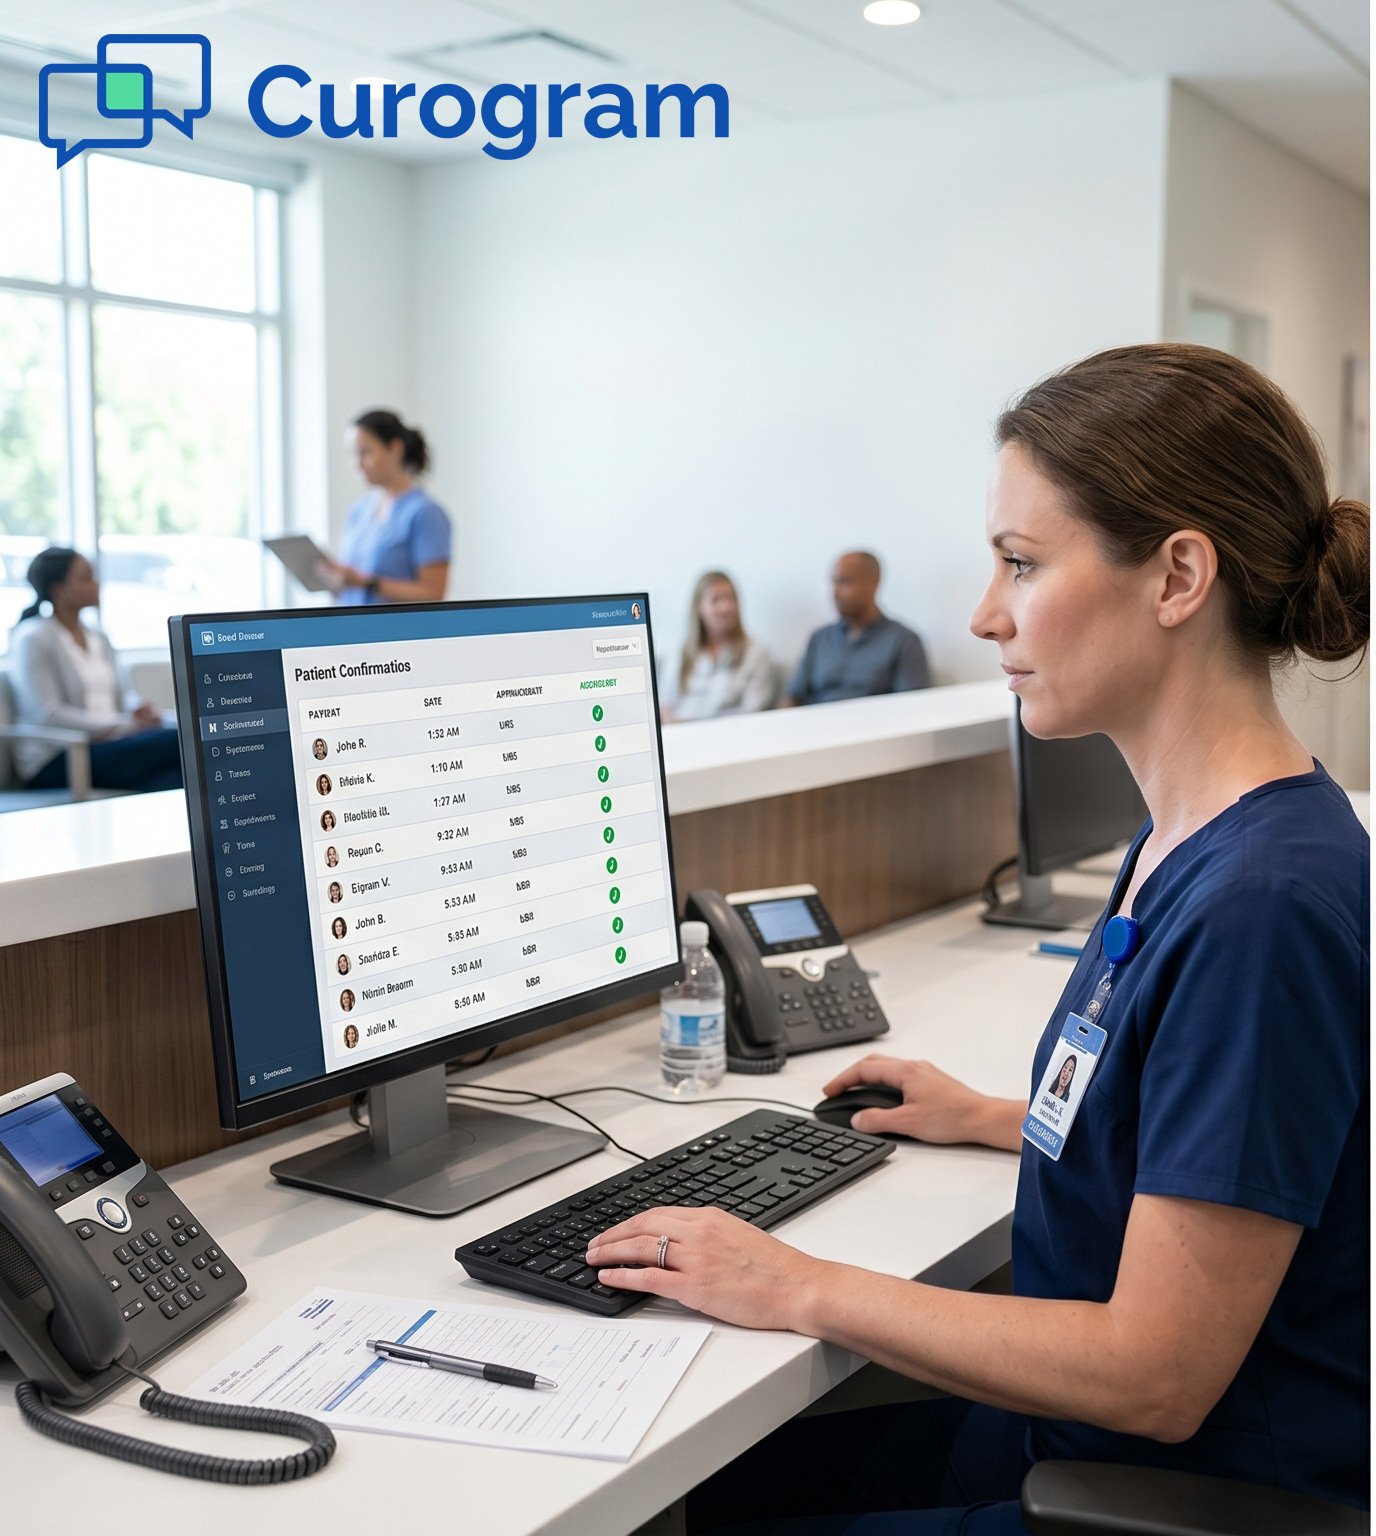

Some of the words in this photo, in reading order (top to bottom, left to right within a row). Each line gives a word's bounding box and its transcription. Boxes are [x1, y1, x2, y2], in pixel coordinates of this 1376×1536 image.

[295, 666, 337, 682] Patient
[339, 659, 411, 678] Confirmatios
[427, 728, 445, 740] 1:52
[446, 727, 460, 737] AM
[336, 740, 357, 754] Johe
[358, 738, 367, 749] R.
[430, 762, 448, 773] 1:10
[450, 760, 463, 771] AM
[366, 773, 375, 783] K.
[433, 796, 450, 807] 1:27
[452, 793, 466, 804] AM
[437, 829, 454, 841] 9:32
[456, 827, 469, 838] AM
[375, 842, 384, 853] C.
[440, 864, 458, 875] 9:53
[459, 860, 473, 871] AM
[381, 877, 391, 887] V.
[462, 893, 476, 905] AM
[355, 917, 376, 930] John
[377, 914, 386, 925] B.
[466, 926, 480, 938] AM
[392, 946, 400, 957] E.
[469, 959, 483, 971] AM
[472, 992, 486, 1004] AM
